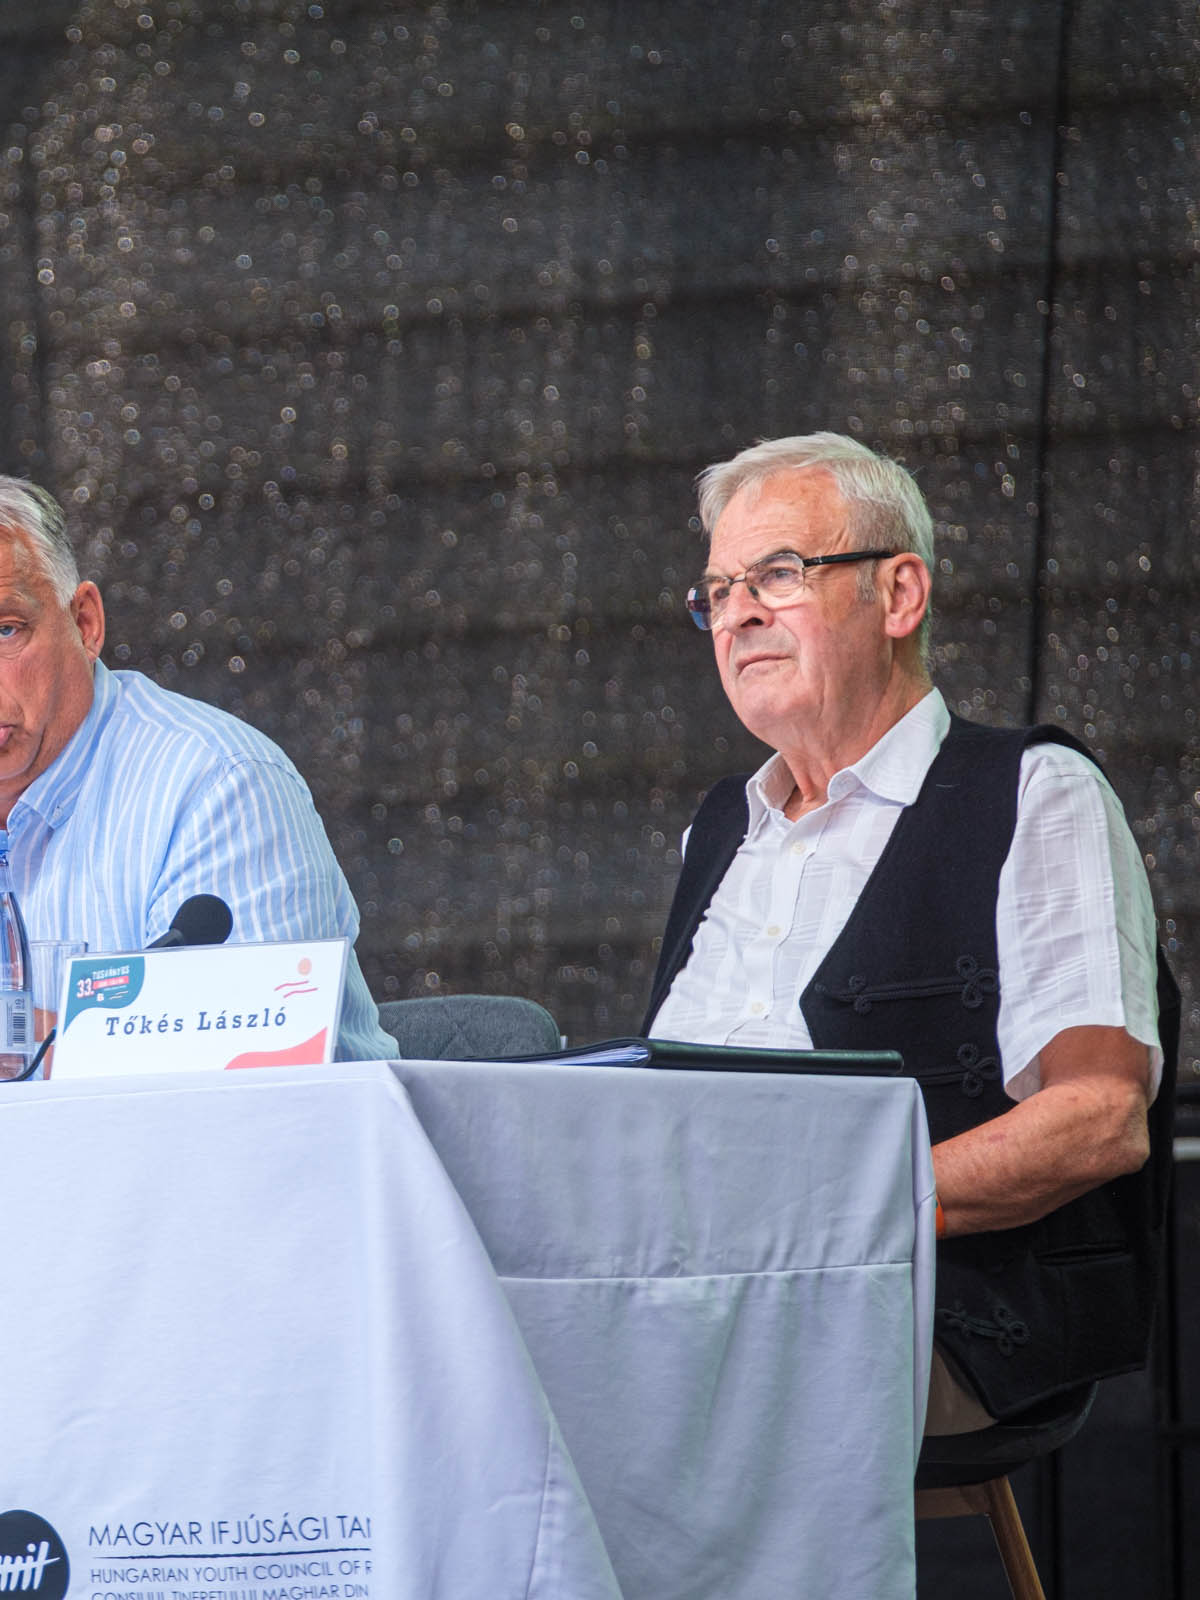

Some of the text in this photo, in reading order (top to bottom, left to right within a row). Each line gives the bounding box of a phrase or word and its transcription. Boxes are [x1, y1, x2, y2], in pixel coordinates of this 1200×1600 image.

[77, 977, 95, 998] 33.
[105, 1006, 287, 1036] Tőkés László
[88, 1521, 202, 1546] MAGYAR
[211, 1512, 329, 1545] IFJÚSÁGI
[90, 1567, 189, 1584] HUNGARIAN
[194, 1566, 248, 1582] YOUTH
[253, 1561, 334, 1581] COUNCIL
[339, 1560, 361, 1576] OF
[262, 1585, 340, 1600] MAGHIAR
[344, 1584, 369, 1598] DIN
